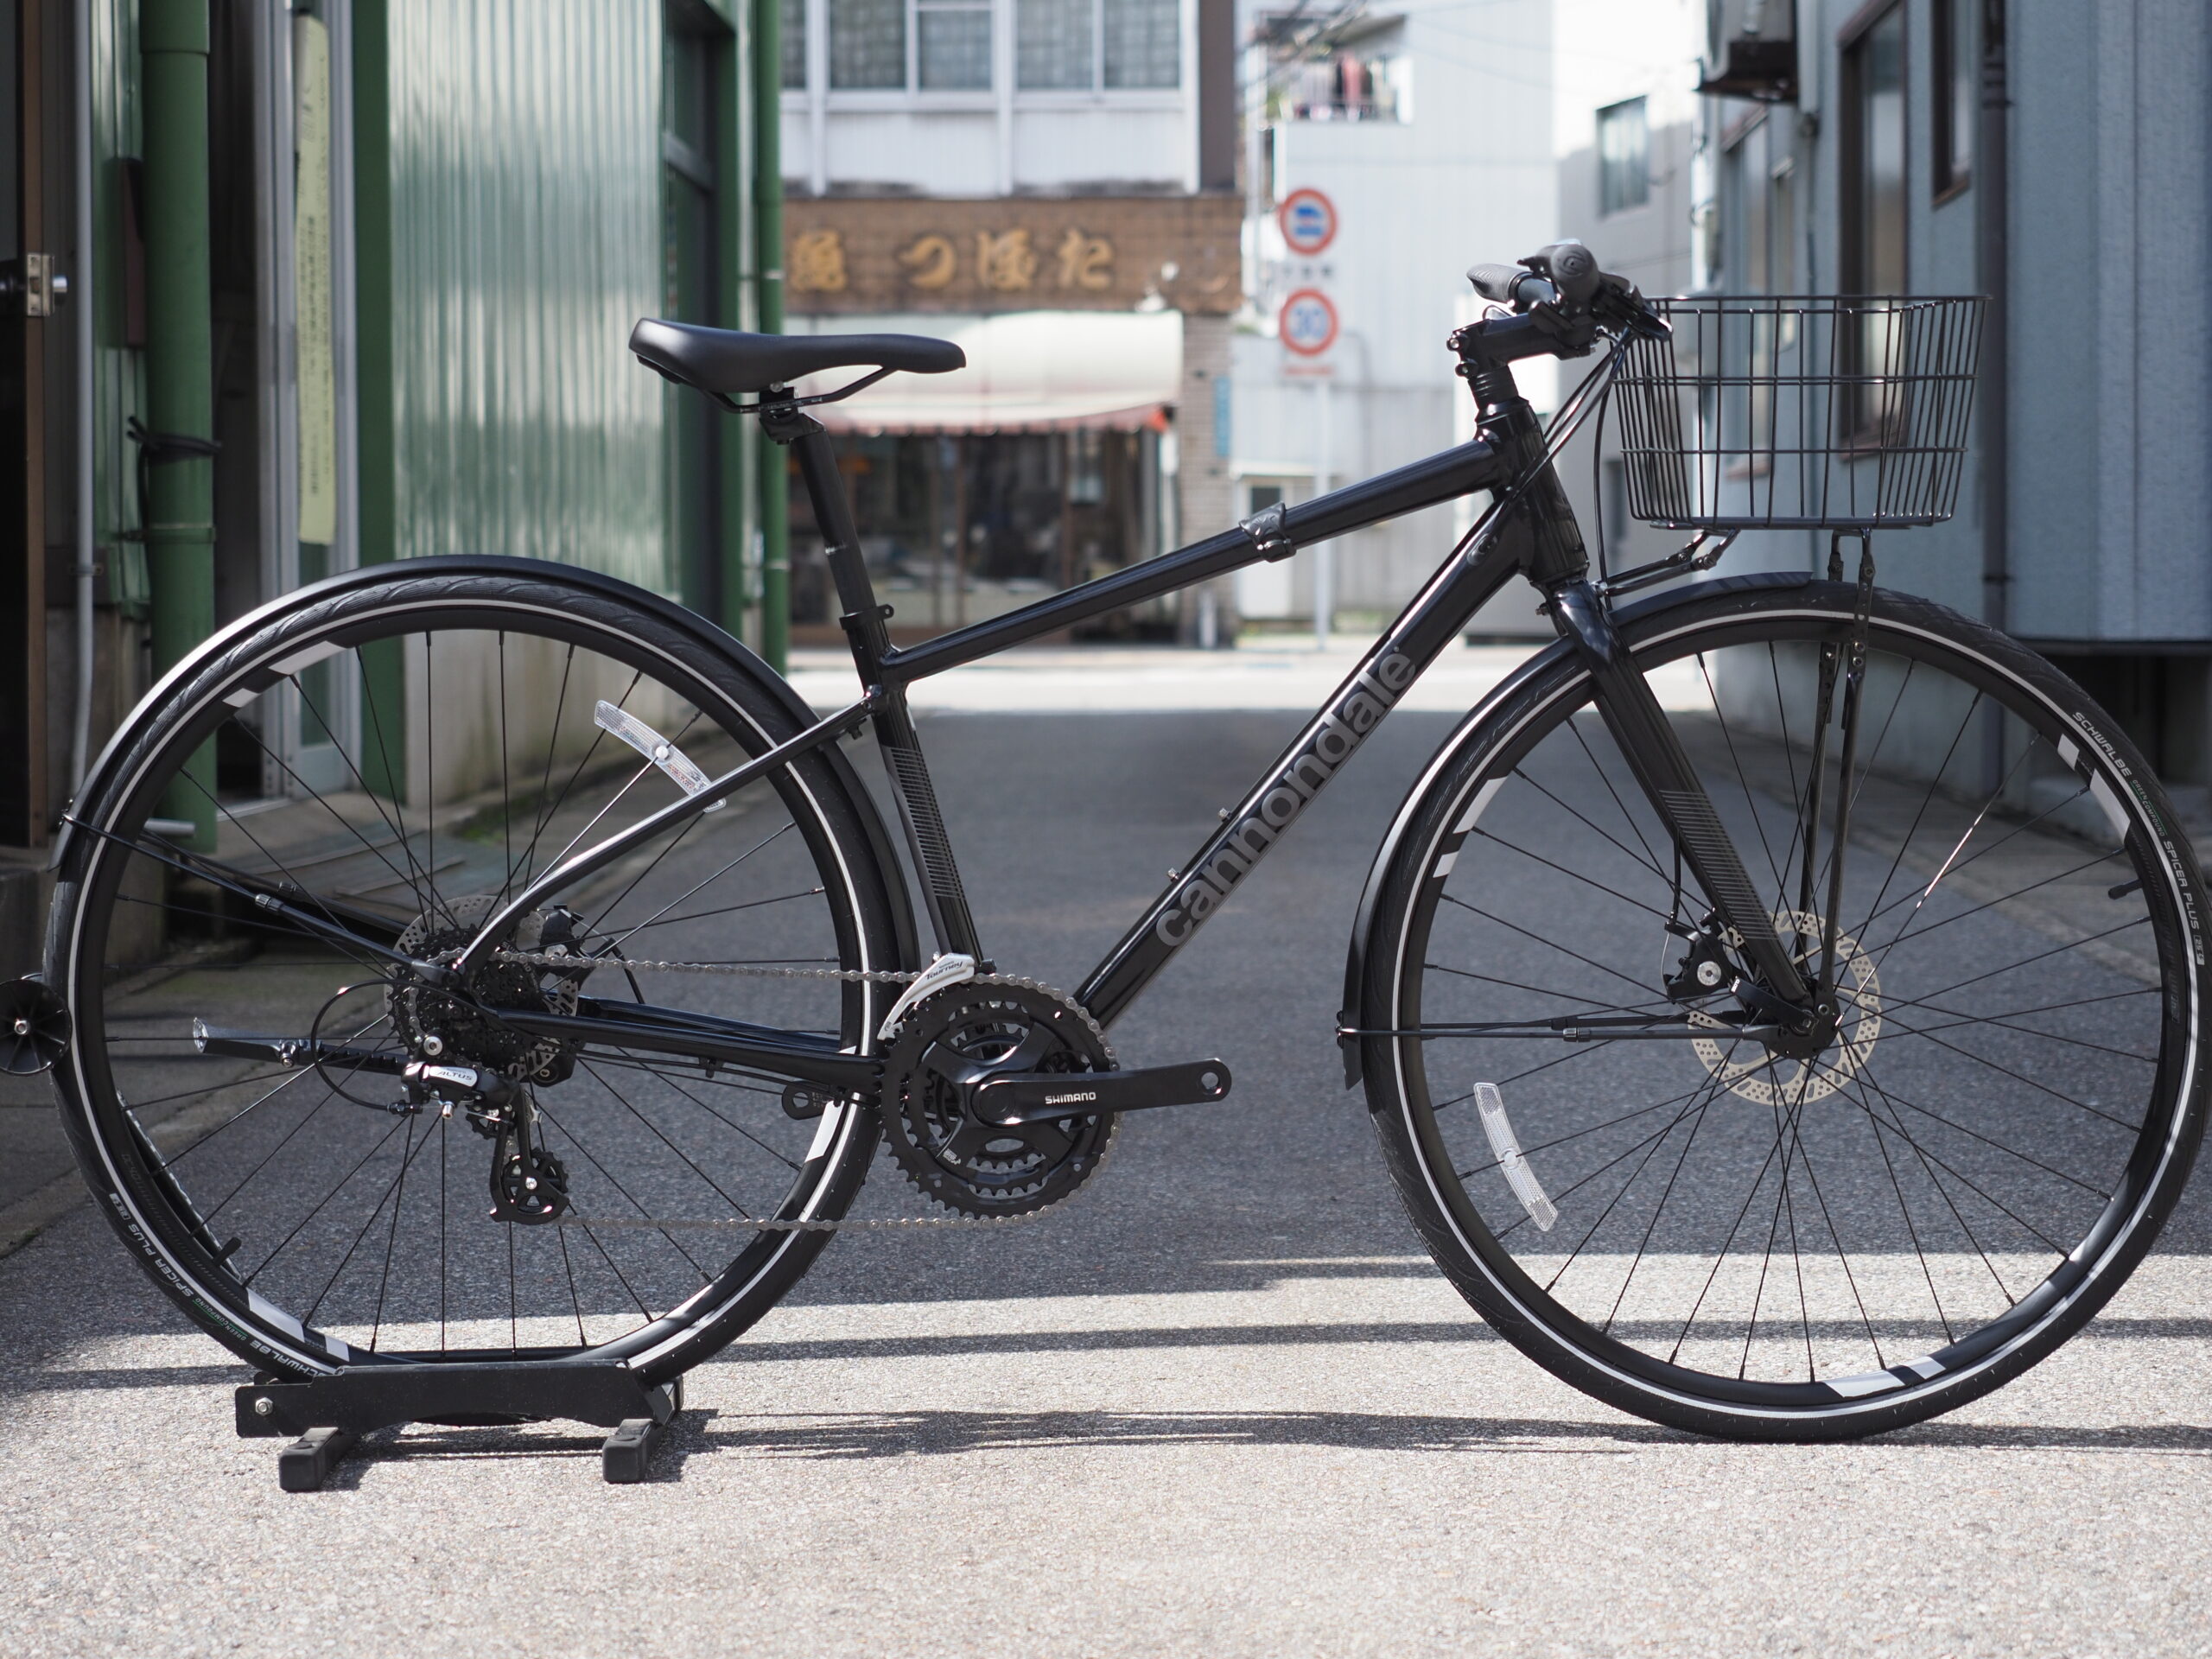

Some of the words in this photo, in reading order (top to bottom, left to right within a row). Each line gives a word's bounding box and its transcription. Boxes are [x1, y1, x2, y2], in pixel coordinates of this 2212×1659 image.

[1155, 652, 1416, 947] cannondale
[2072, 711, 2133, 778] SCHWALBE
[2142, 800, 2165, 837] COMPOUND
[2163, 840, 2188, 887] SPICER
[2183, 893, 2200, 930] PLUS
[925, 961, 963, 981] Tourney
[436, 1071, 474, 1081] ALTUS
[1044, 1091, 1096, 1105] SHIMANO
[128, 1224, 156, 1256] PLUS
[154, 1258, 194, 1298] SPICER
[195, 1297, 228, 1329] COMPOUND
